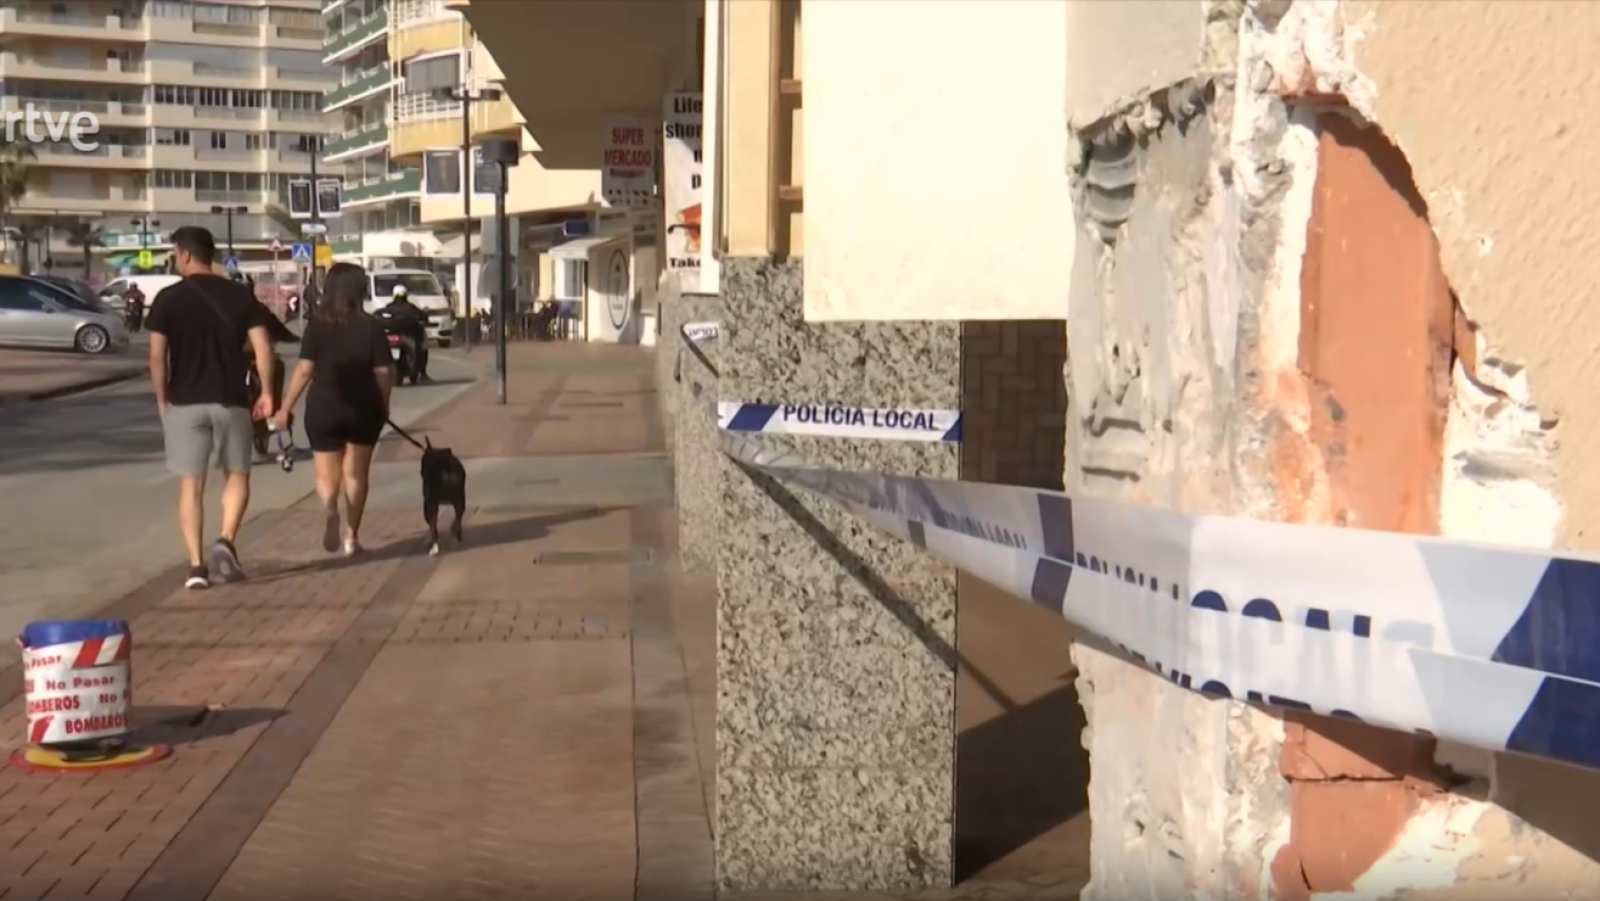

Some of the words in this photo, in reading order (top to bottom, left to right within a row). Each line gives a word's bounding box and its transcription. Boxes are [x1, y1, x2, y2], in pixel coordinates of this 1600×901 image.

[612, 127, 644, 145] SUPER
[604, 149, 652, 167] MERCADO
[873, 409, 939, 430] LOCAL
[46, 681, 66, 691] No
[73, 677, 115, 688] Pasar
[100, 694, 118, 704] No
